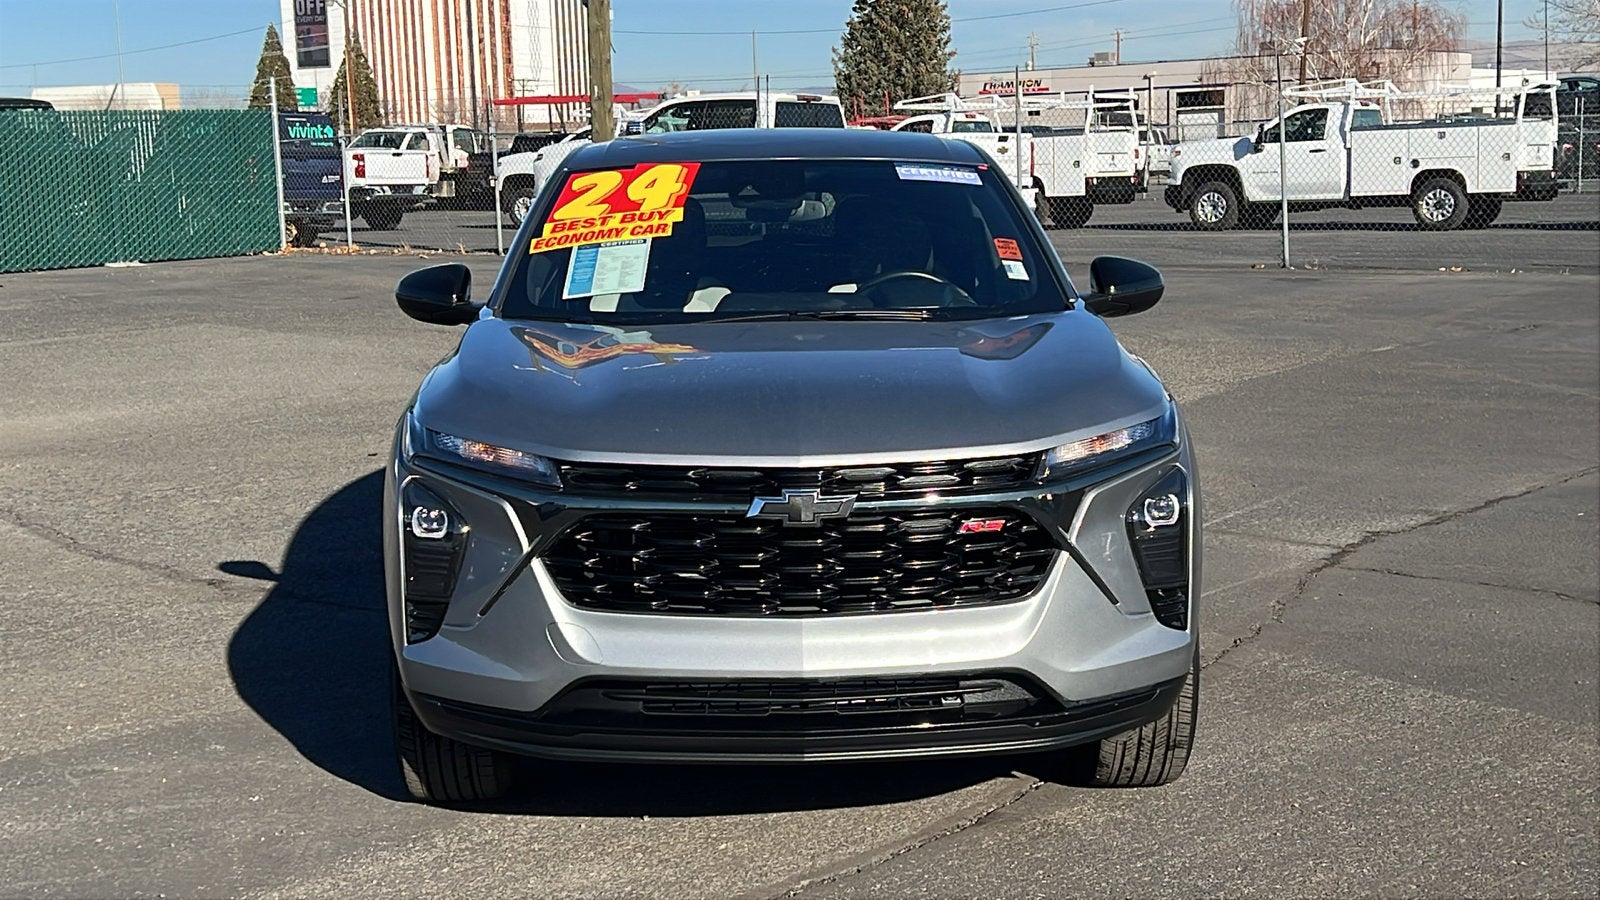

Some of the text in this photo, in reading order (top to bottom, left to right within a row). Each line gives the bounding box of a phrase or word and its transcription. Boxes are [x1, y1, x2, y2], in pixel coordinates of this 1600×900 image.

[296, 0, 323, 15] OFF
[287, 122, 323, 139] vivint
[900, 167, 976, 180] CERTIFIED
[553, 164, 687, 220] 24
[550, 209, 675, 234] BEST BUY
[533, 223, 670, 250] ECONOMY CAR
[600, 239, 645, 248] CERTIFIED
[959, 519, 1006, 534] RS
